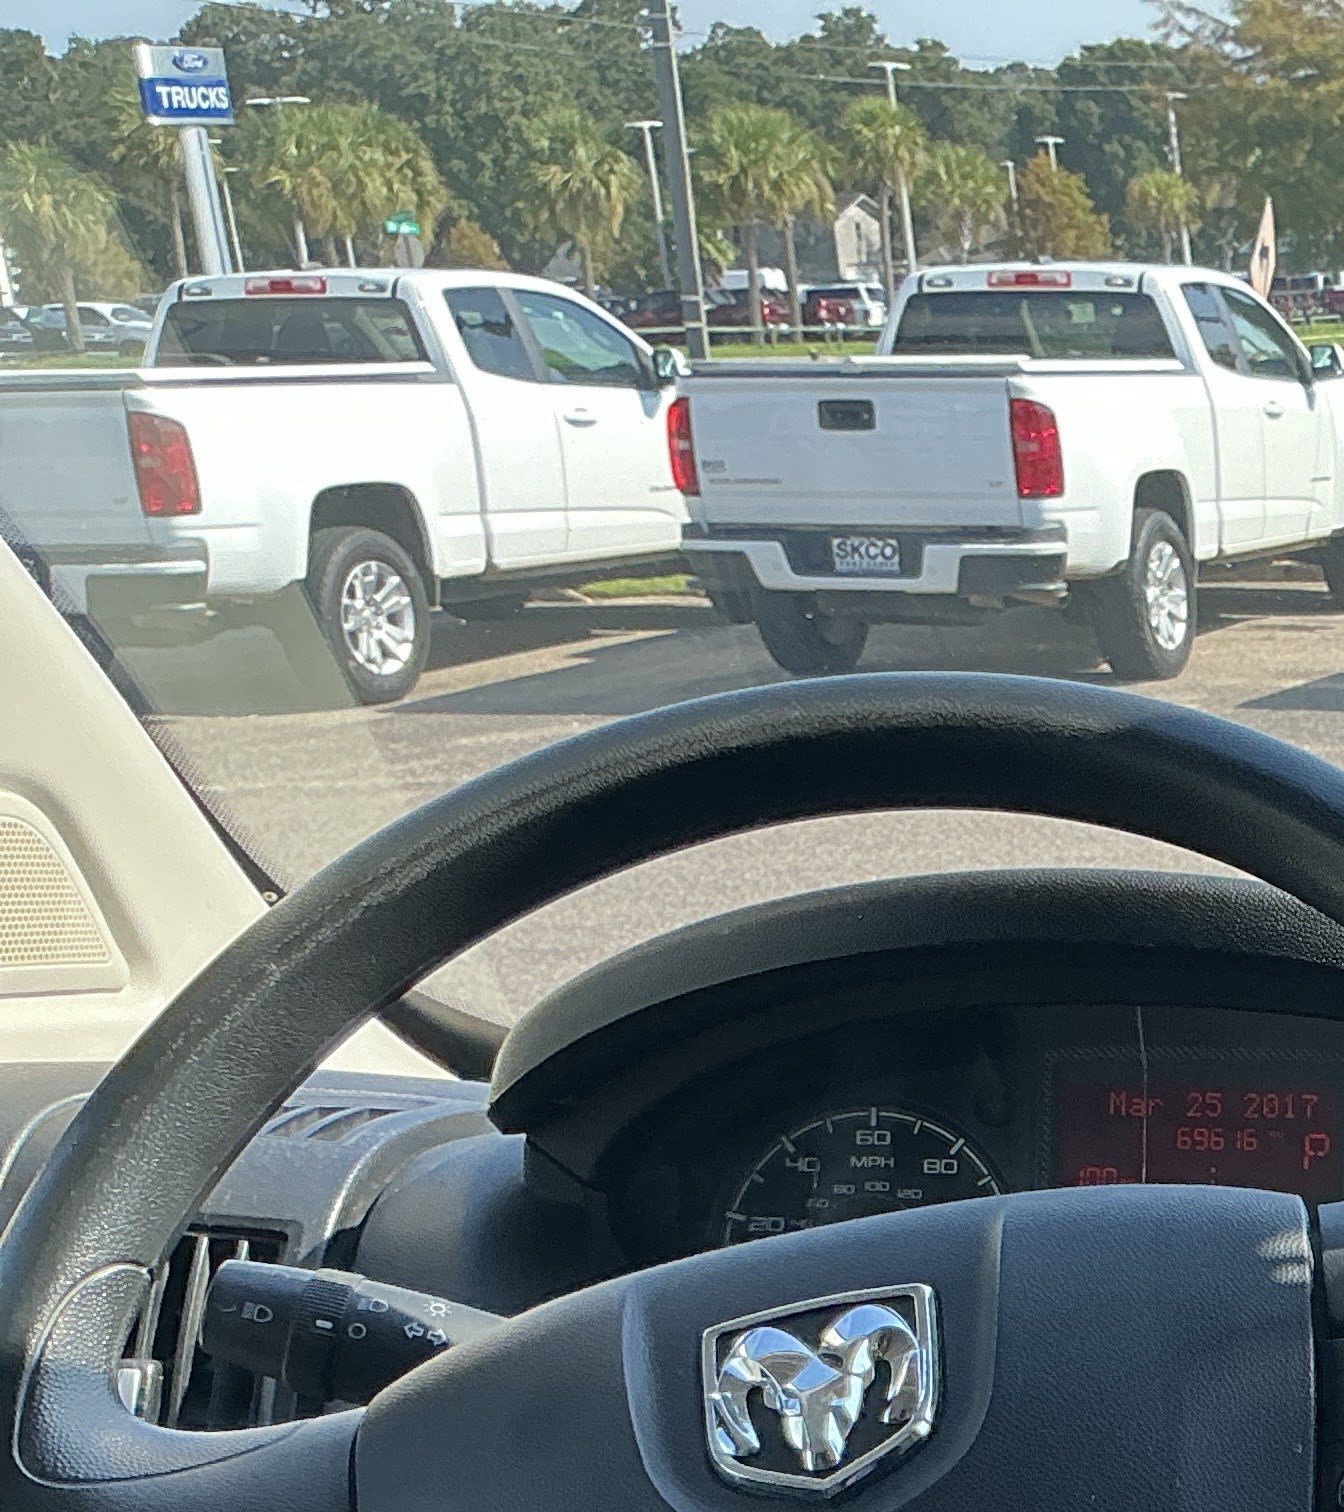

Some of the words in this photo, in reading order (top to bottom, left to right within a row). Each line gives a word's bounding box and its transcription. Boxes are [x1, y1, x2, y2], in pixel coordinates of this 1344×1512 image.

[155, 85, 229, 111] TRUCKS
[835, 540, 896, 561] SKCO
[1107, 1090, 1163, 1117] Mar
[1186, 1092, 1222, 1119] 25
[1243, 1093, 1319, 1120] 2017
[855, 1130, 891, 1147] 60
[1303, 1132, 1331, 1170] P
[785, 1157, 821, 1173] 40
[850, 1156, 894, 1169] MPH
[923, 1159, 958, 1175] 80
[748, 1216, 786, 1232] 20
